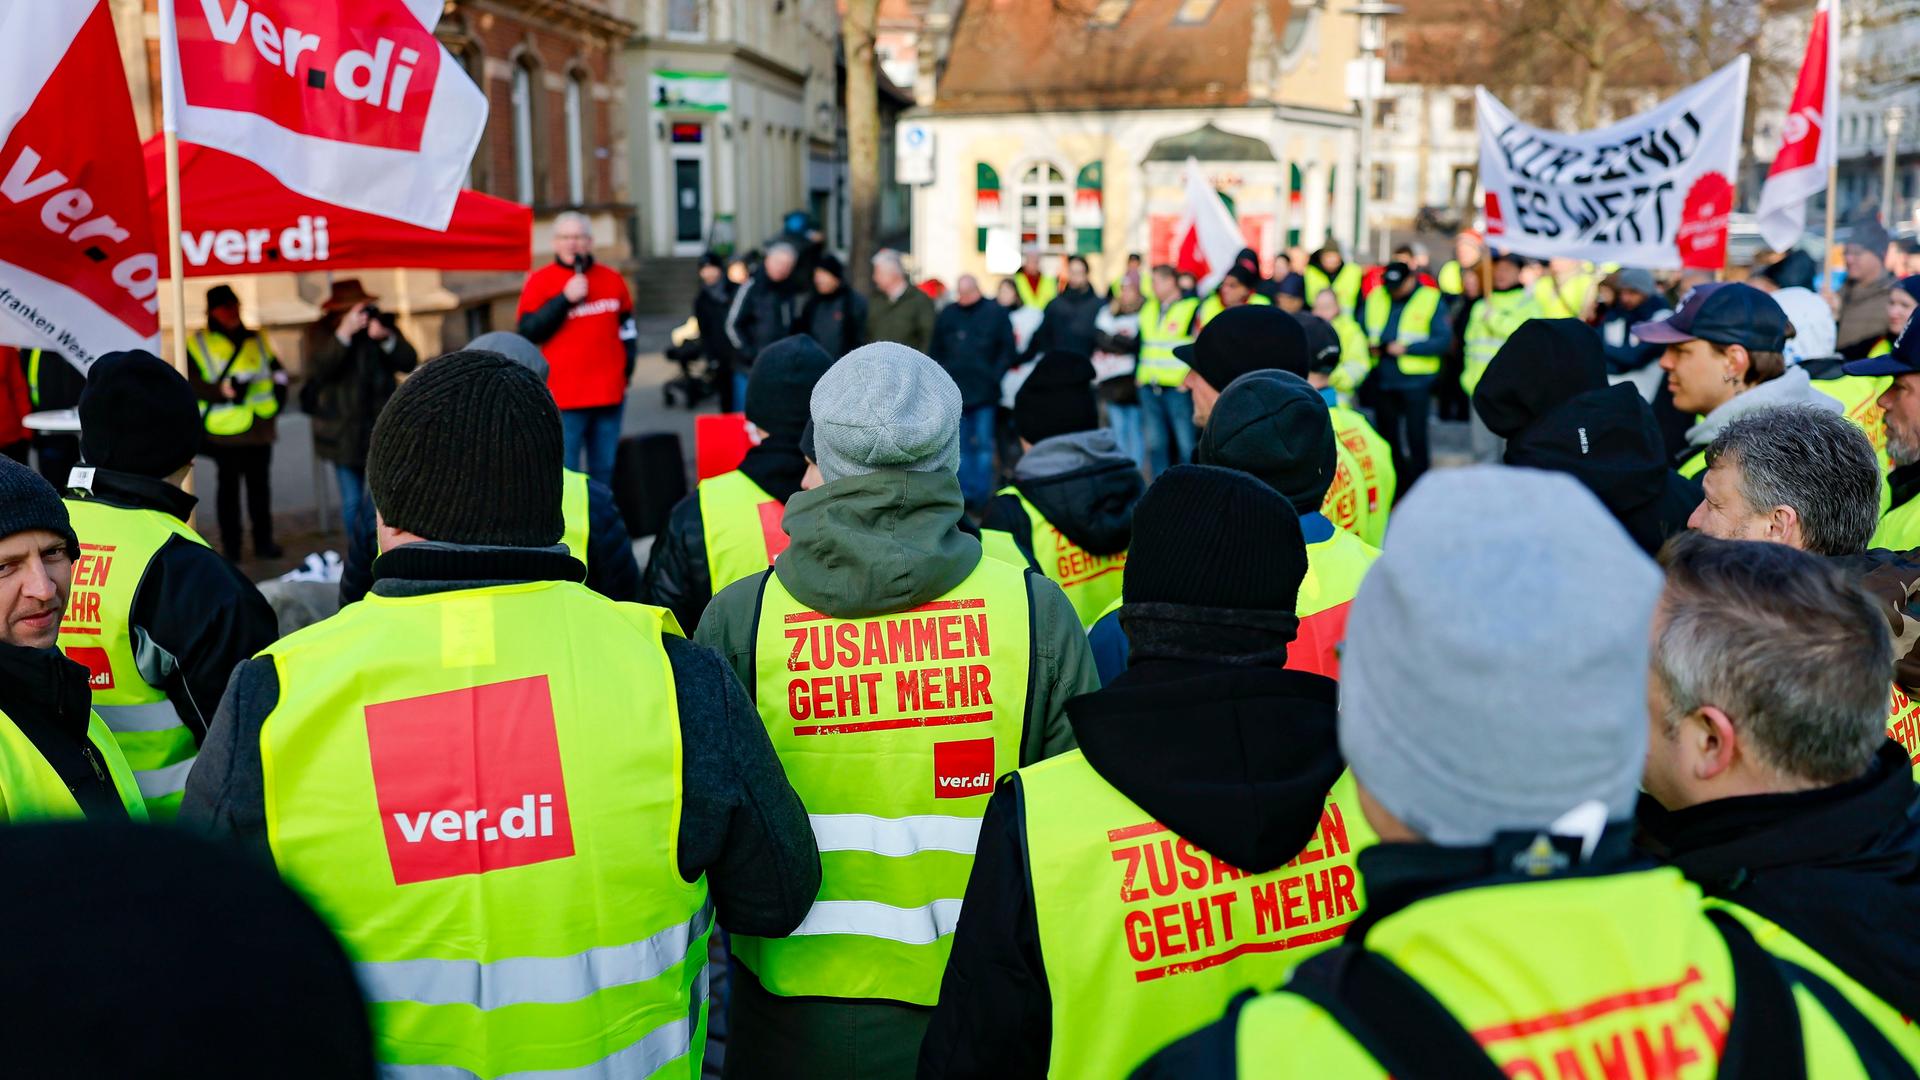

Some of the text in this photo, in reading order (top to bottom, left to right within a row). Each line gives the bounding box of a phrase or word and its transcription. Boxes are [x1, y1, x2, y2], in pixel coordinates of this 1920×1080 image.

[203, 0, 419, 113] ver.di
[0, 145, 159, 315] ver.d
[1511, 186, 1561, 237] ES
[180, 214, 330, 267] ver.di
[0, 286, 56, 336] franken
[784, 613, 991, 672] ZUSAMMEN
[788, 664, 993, 721] GEHT MEHR
[938, 773, 991, 788] ver.di
[393, 794, 554, 843] ver.di
[1124, 864, 1360, 962] GEHT MEHR
